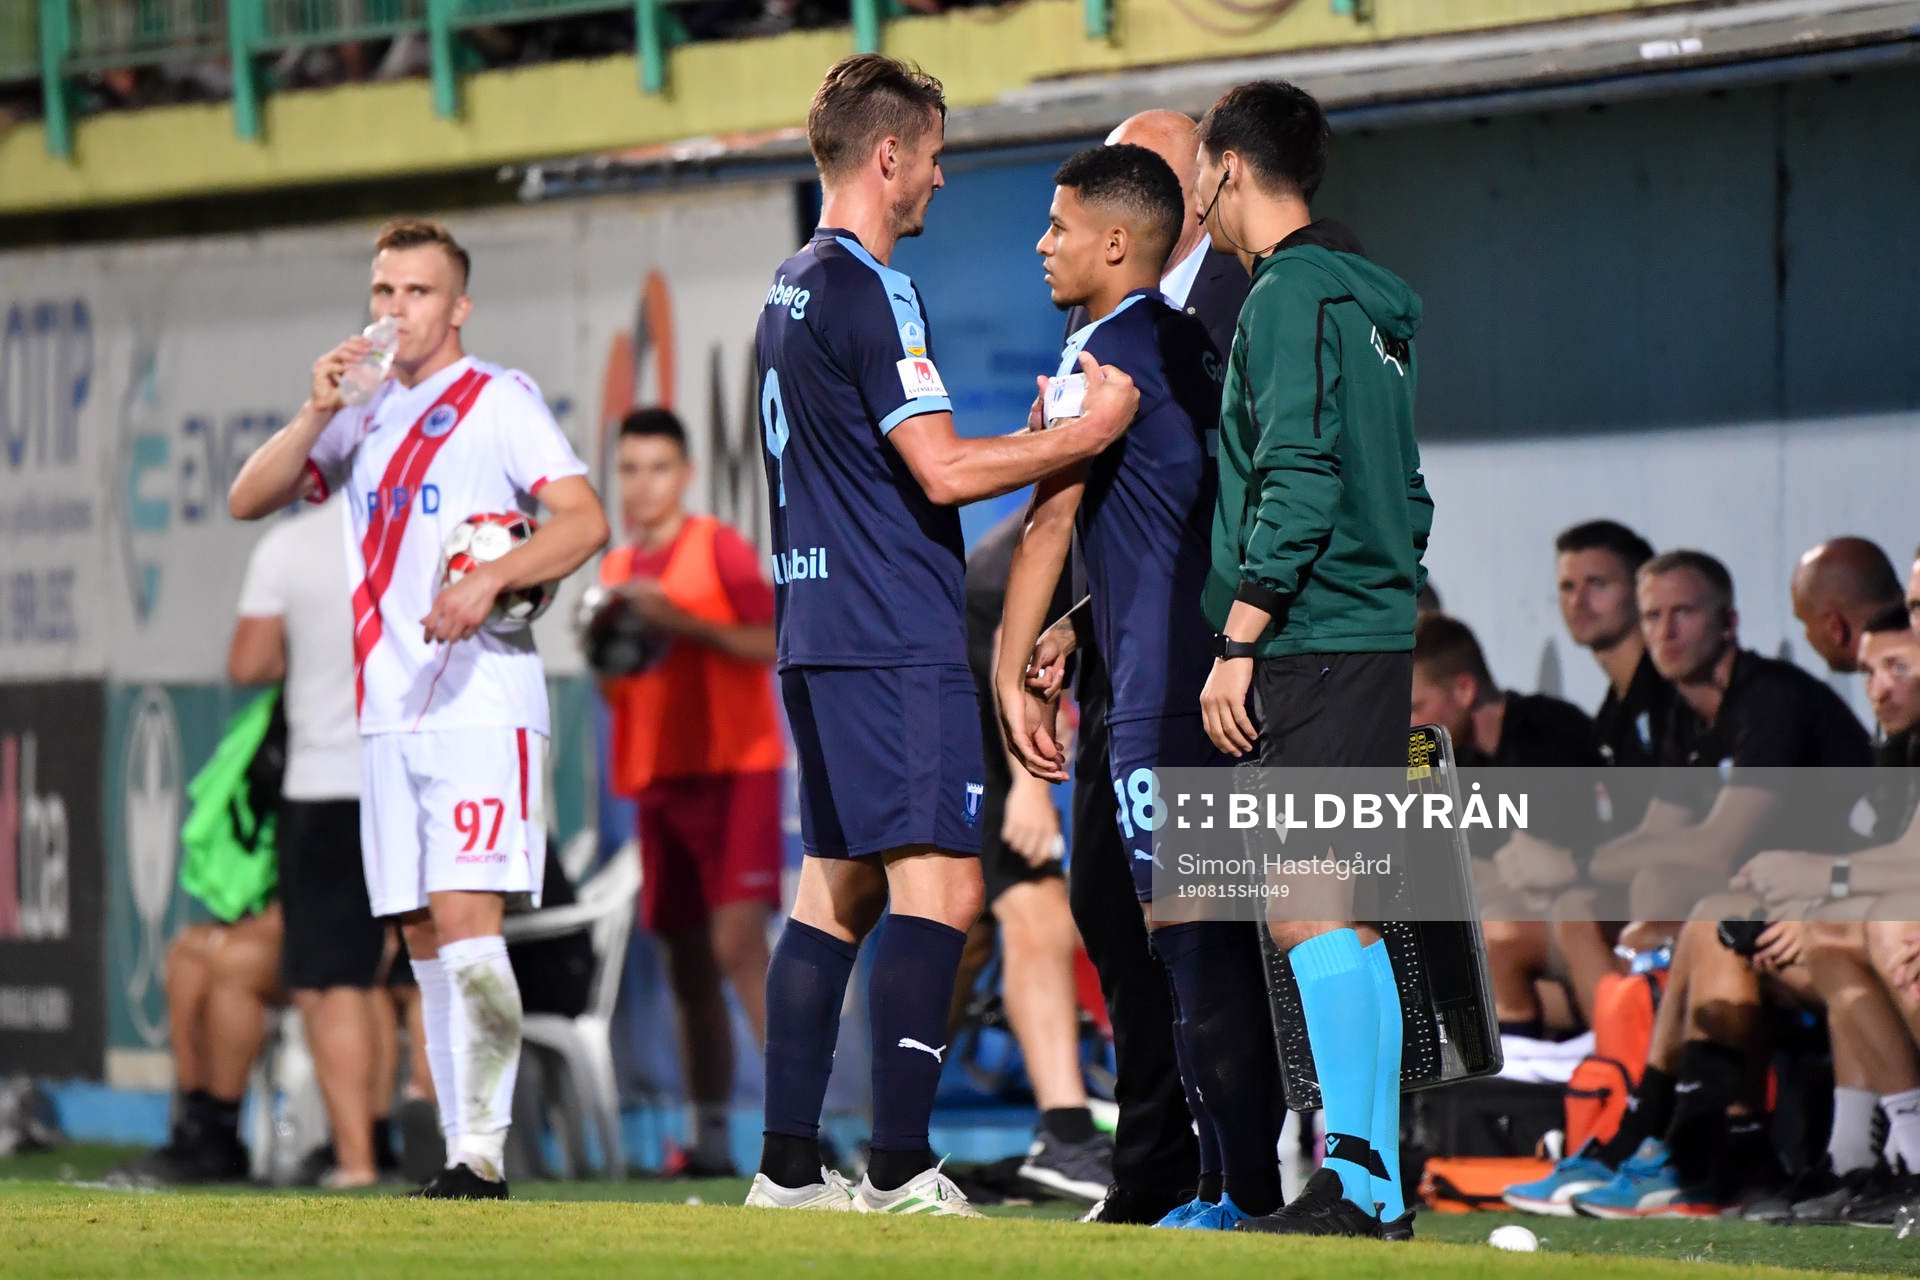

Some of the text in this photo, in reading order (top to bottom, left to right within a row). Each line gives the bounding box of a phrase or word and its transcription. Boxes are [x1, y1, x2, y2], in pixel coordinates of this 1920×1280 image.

[762, 367, 790, 508] 9
[454, 798, 504, 851] 97
[1113, 767, 1168, 838] 18
